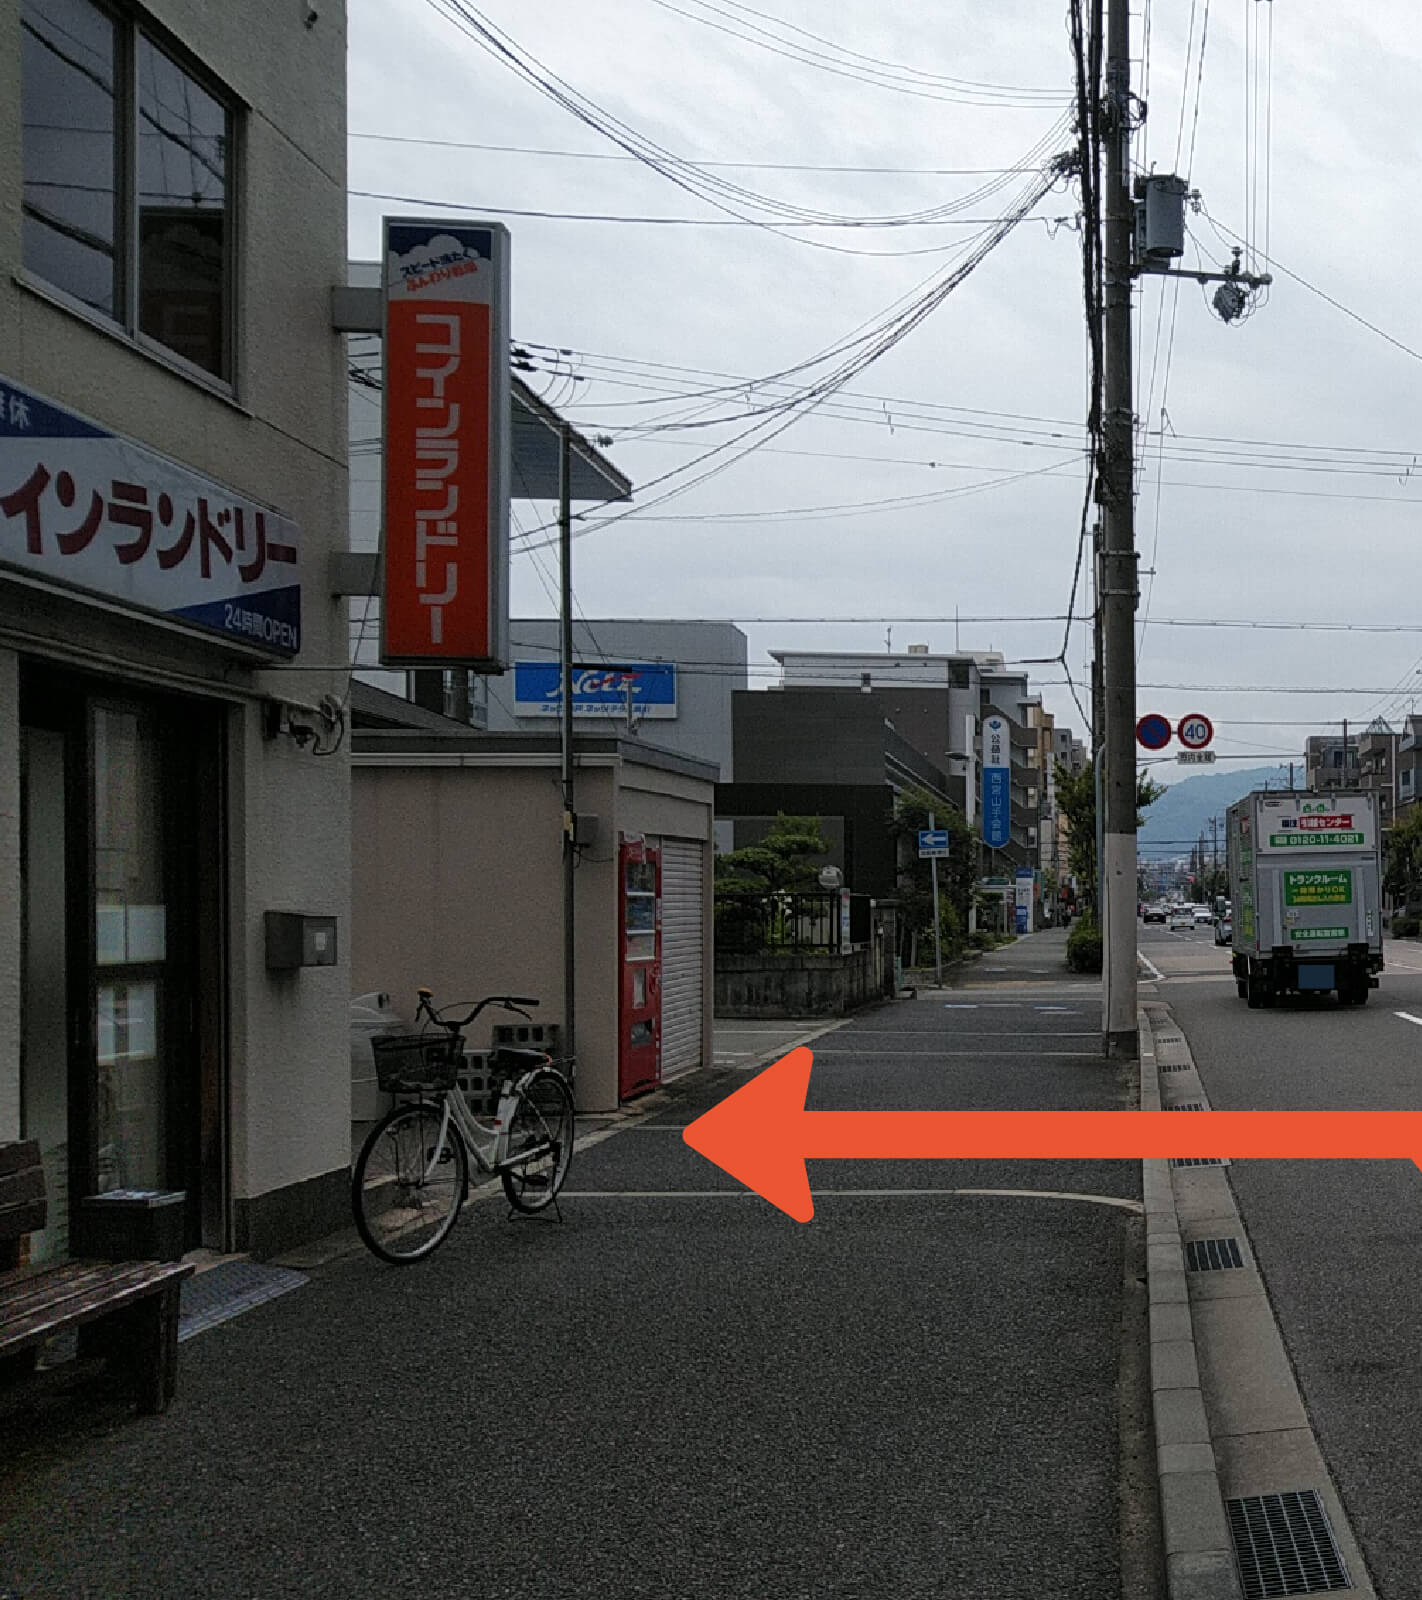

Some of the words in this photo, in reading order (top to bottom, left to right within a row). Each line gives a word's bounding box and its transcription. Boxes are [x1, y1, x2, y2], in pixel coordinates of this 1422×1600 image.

[416, 313, 461, 644] コインランドリー
[0, 463, 297, 583] インランドリー
[1184, 724, 1206, 739] 40
[1289, 874, 1347, 886] トランクルーム
